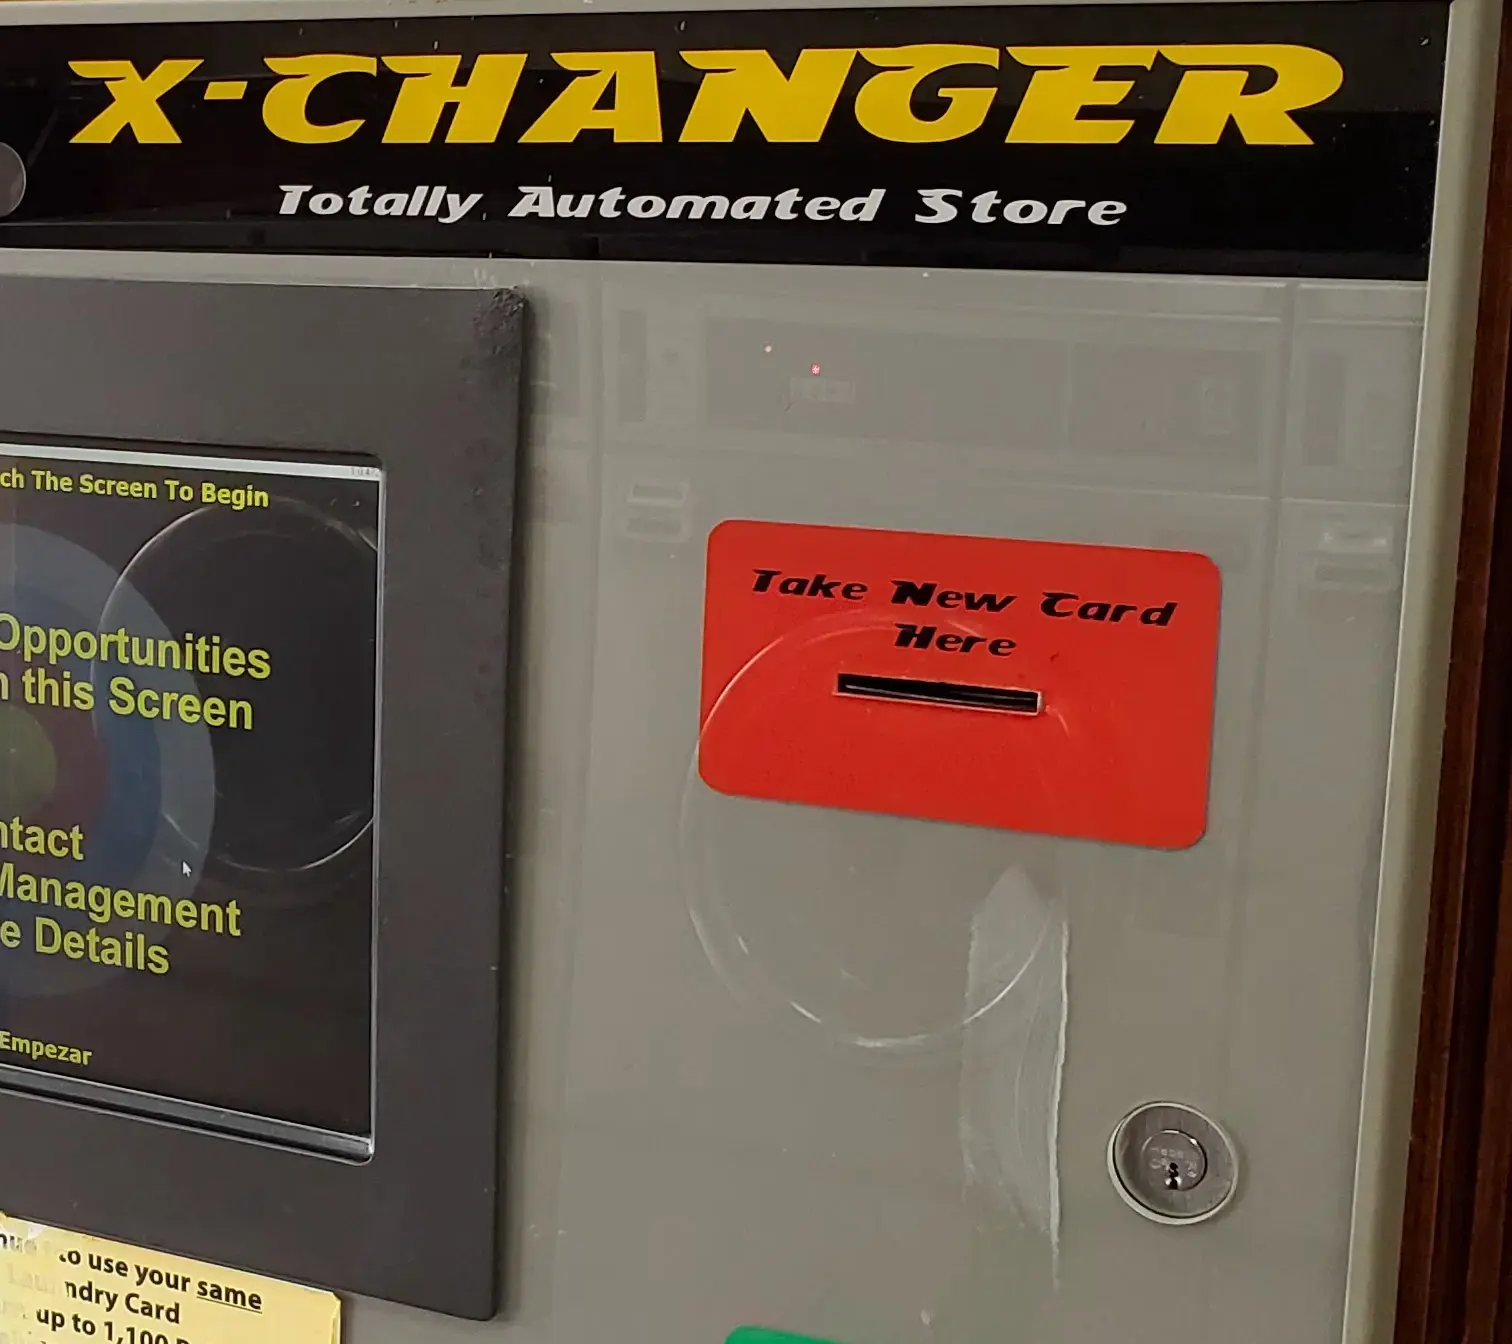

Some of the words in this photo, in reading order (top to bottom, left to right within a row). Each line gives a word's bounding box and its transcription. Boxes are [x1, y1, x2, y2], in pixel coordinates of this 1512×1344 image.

[67, 43, 1345, 146] X-CHANGER
[278, 184, 484, 224] Totally
[507, 185, 887, 223] Automated
[914, 188, 1128, 226] Store
[31, 469, 74, 493] The
[79, 473, 157, 500] Screen
[164, 478, 194, 503] To
[201, 482, 269, 510] Begin
[752, 569, 869, 601] Take
[890, 579, 1017, 614] New
[1040, 591, 1178, 628] Card
[892, 622, 1017, 657] Here
[22, 670, 94, 711] this
[108, 677, 254, 730] Screen
[35, 917, 171, 975] Details
[88, 1253, 129, 1278] use
[134, 1264, 190, 1292] your
[196, 1280, 263, 1313] same
[125, 1292, 180, 1324] Card
[35, 1308, 66, 1333] up
[72, 1313, 96, 1336] to
